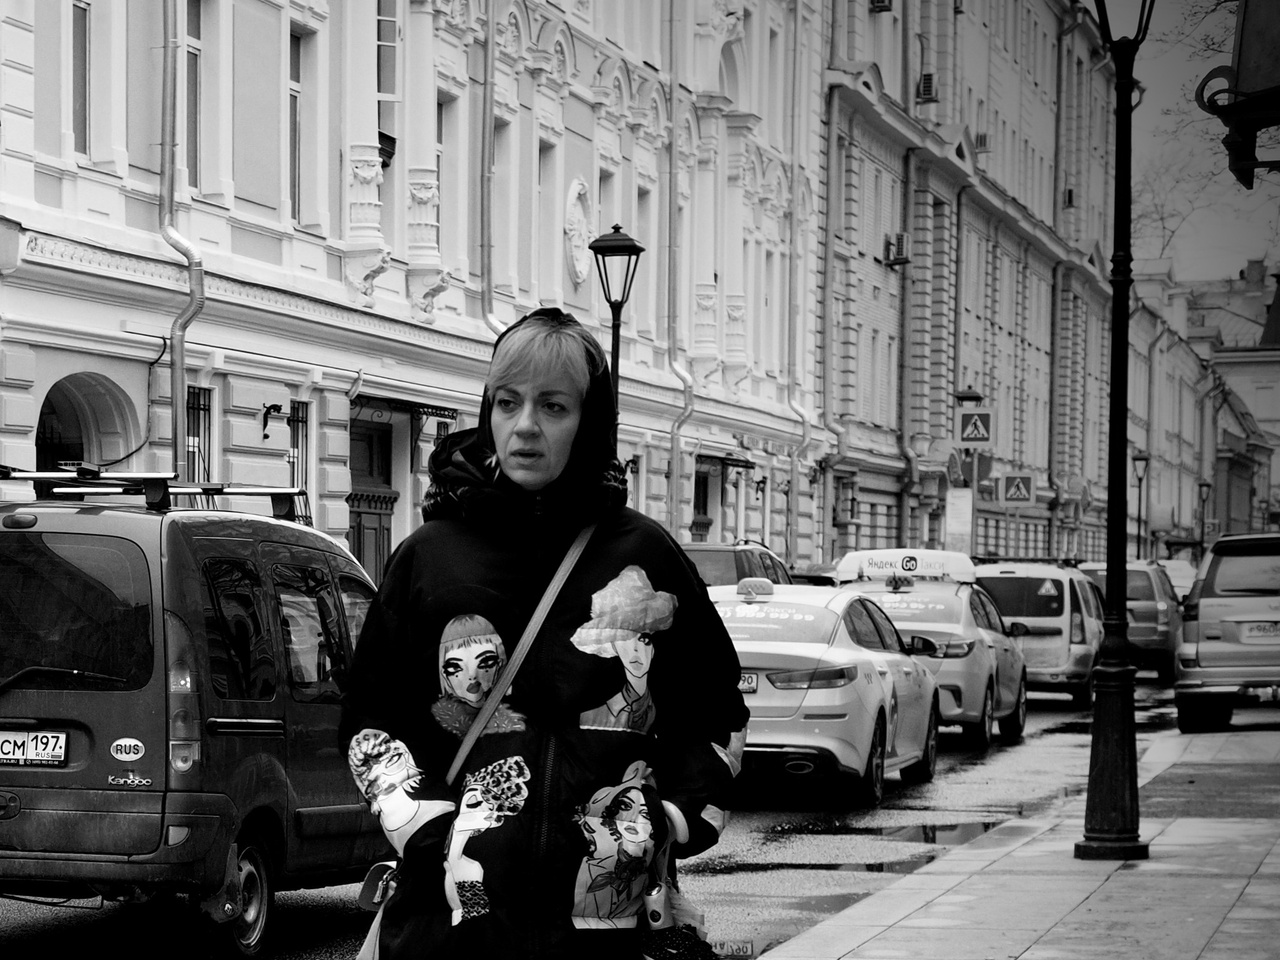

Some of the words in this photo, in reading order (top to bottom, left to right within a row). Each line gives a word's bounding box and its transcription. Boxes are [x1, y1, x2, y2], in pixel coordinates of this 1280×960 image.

[867, 557, 899, 571] Яндекс
[902, 557, 917, 571] Go
[920, 558, 945, 571] Такси
[740, 675, 754, 685] 90
[30, 734, 60, 752] 197
[115, 743, 140, 755] RUS
[35, 751, 51, 759] RUS
[107, 774, 153, 788] Kangoo
